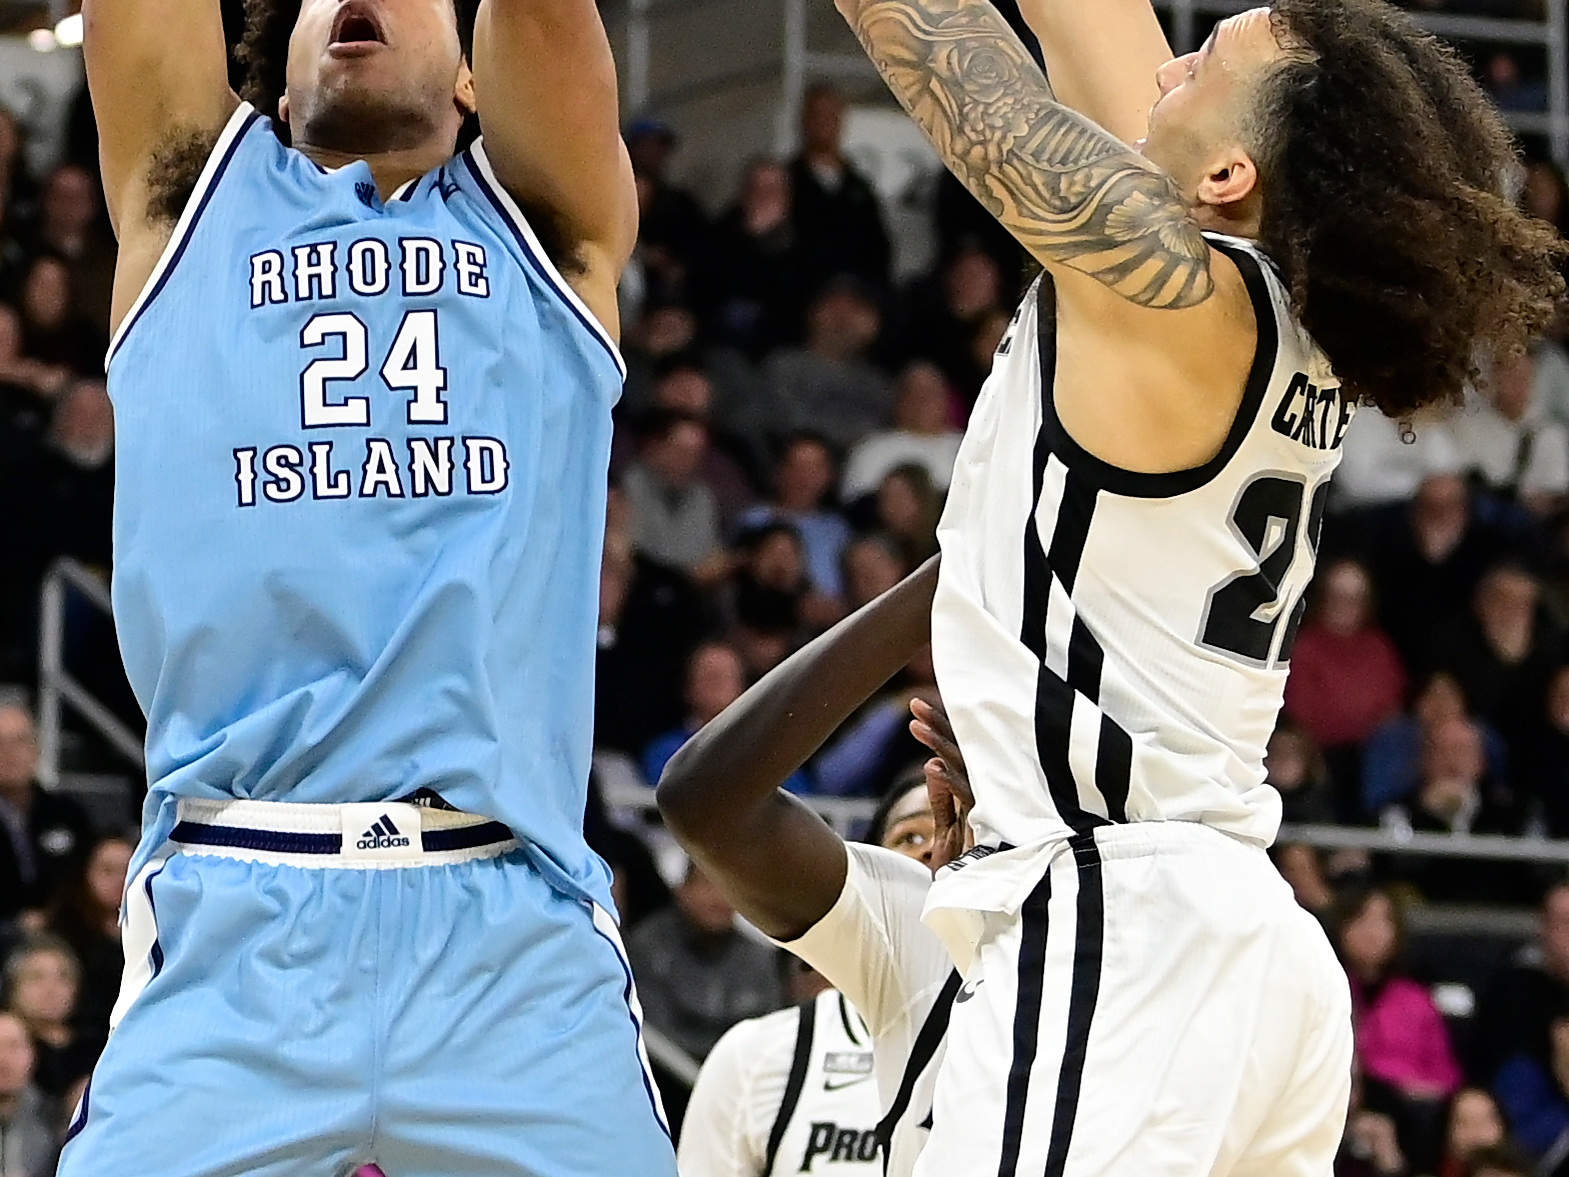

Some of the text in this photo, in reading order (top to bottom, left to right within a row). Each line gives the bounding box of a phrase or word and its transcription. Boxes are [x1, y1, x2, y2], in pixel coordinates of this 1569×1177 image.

[249, 237, 491, 310] RHODE
[299, 309, 449, 430] 24
[233, 436, 510, 507] ISLAND
[356, 835, 410, 850] adidas
